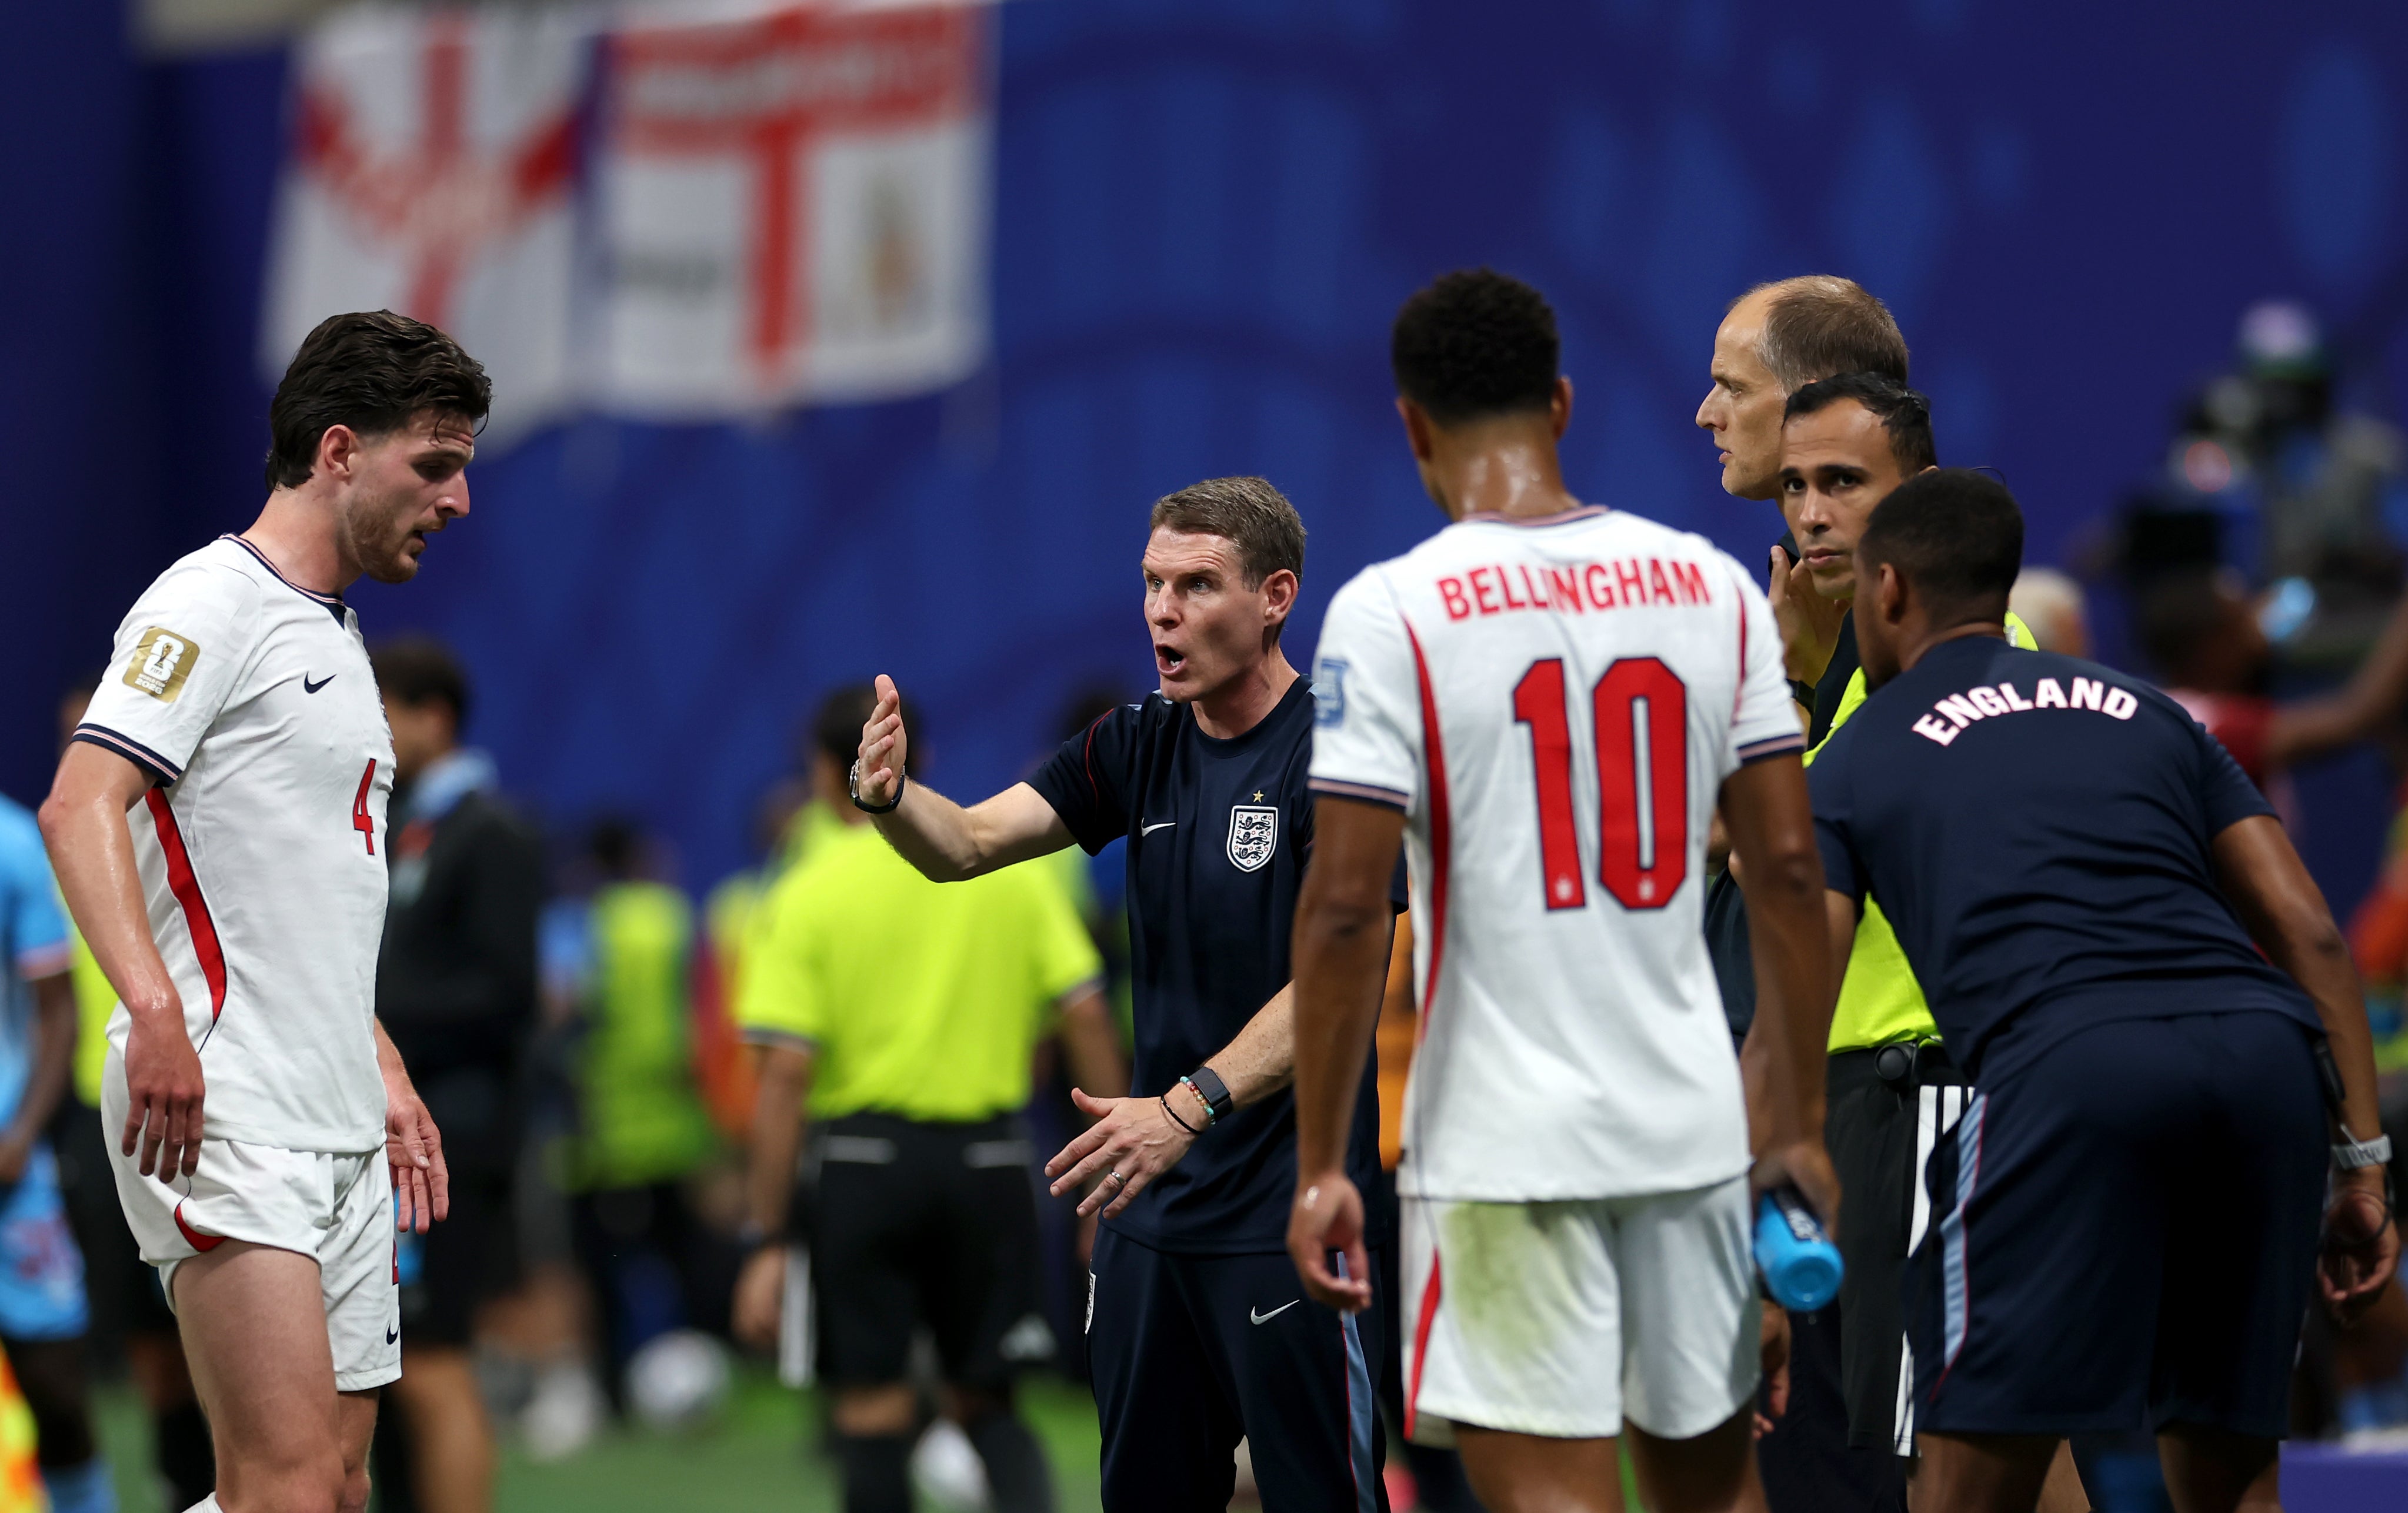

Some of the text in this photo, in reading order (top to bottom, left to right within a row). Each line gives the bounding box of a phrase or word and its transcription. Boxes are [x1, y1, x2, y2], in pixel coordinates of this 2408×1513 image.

[1438, 561, 1710, 621] BELLINGHAM
[134, 677, 163, 694] 2026
[150, 667, 162, 676] FIFA
[1912, 676, 2139, 747] ENGLAND
[353, 758, 376, 856] 4
[1512, 656, 1687, 911] 10
